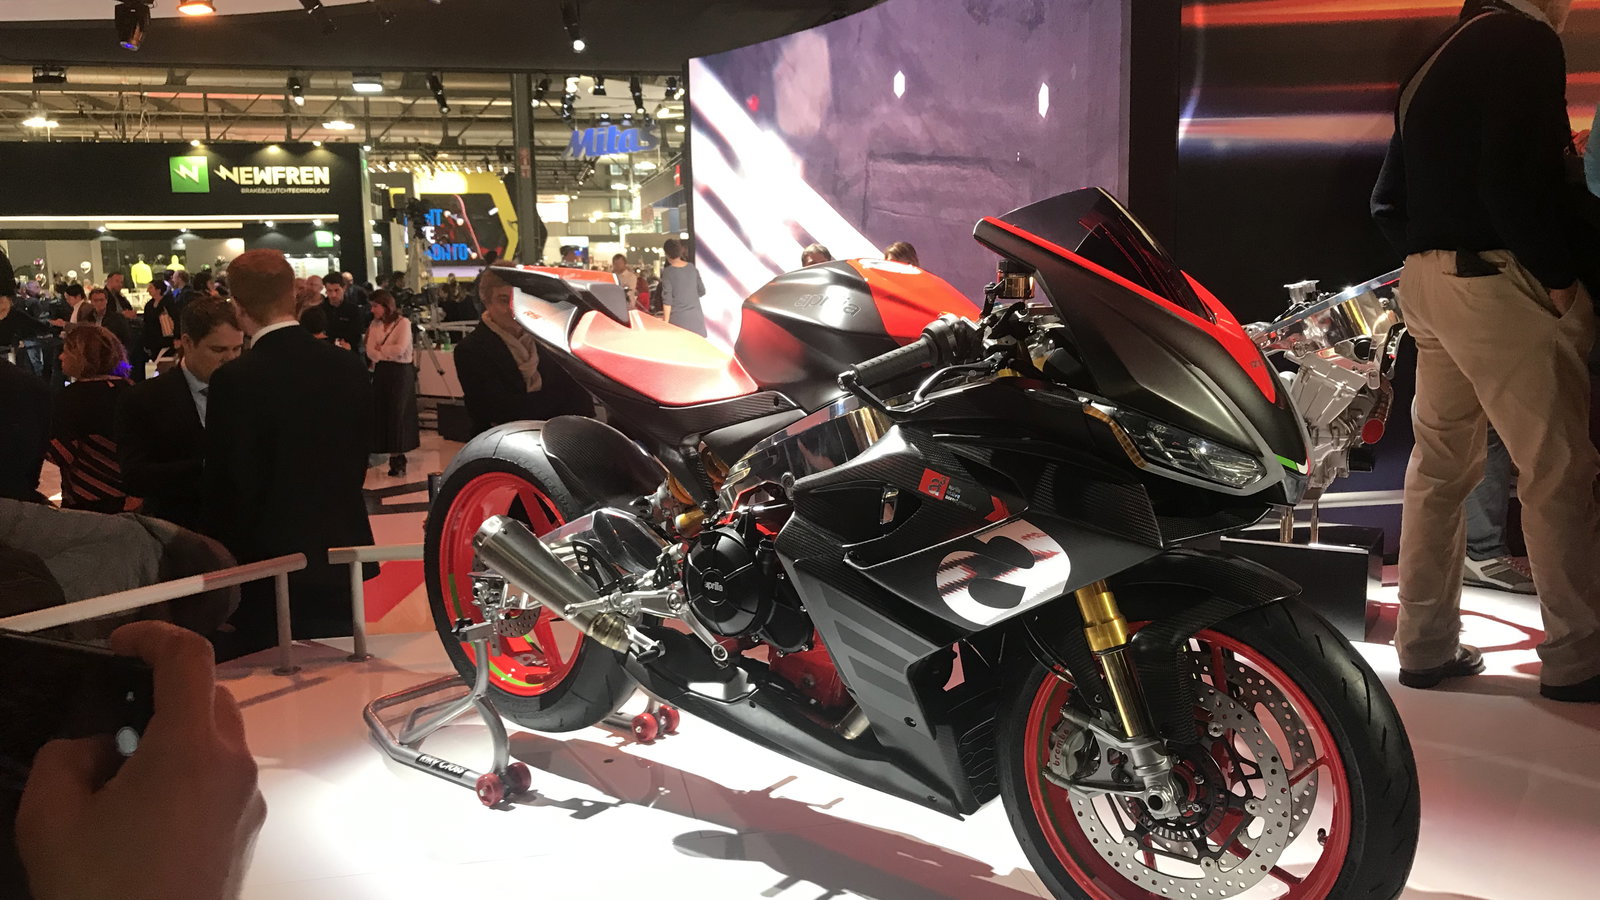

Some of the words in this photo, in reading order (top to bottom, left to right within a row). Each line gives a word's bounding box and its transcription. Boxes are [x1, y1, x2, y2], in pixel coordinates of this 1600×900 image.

[561, 125, 659, 159] Mitas
[213, 164, 330, 185] NEWFREN
[424, 243, 469, 261] ONTO
[1053, 729, 1069, 767] brembo
